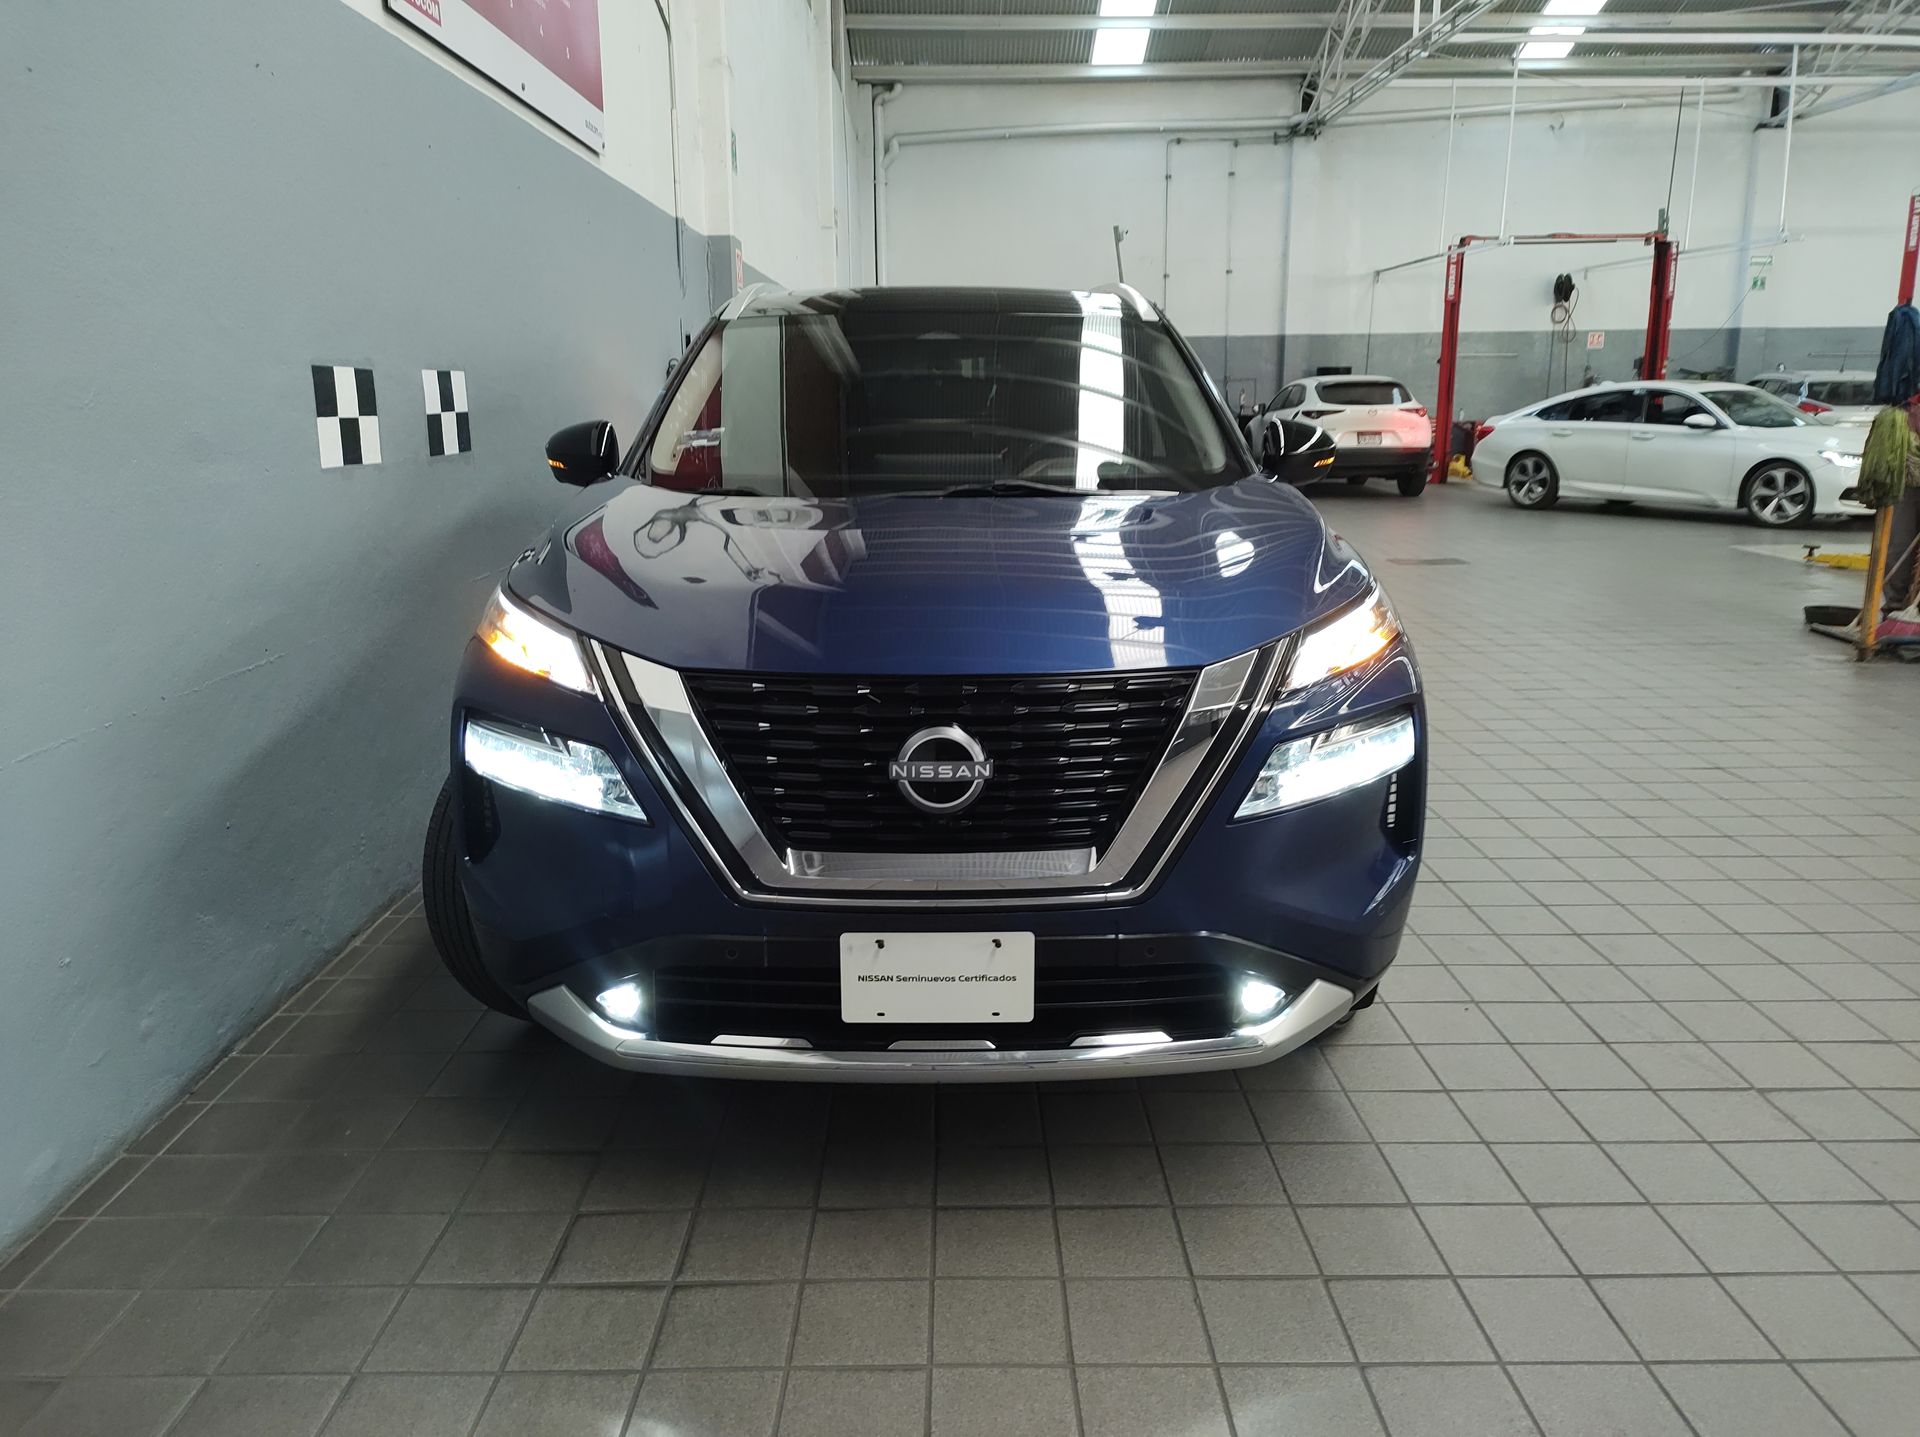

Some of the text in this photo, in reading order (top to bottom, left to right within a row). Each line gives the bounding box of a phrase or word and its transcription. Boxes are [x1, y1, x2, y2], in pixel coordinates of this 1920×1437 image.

[892, 764, 990, 778] NISSAN
[857, 974, 1017, 983] NISSAN Seminuevos Certificados
